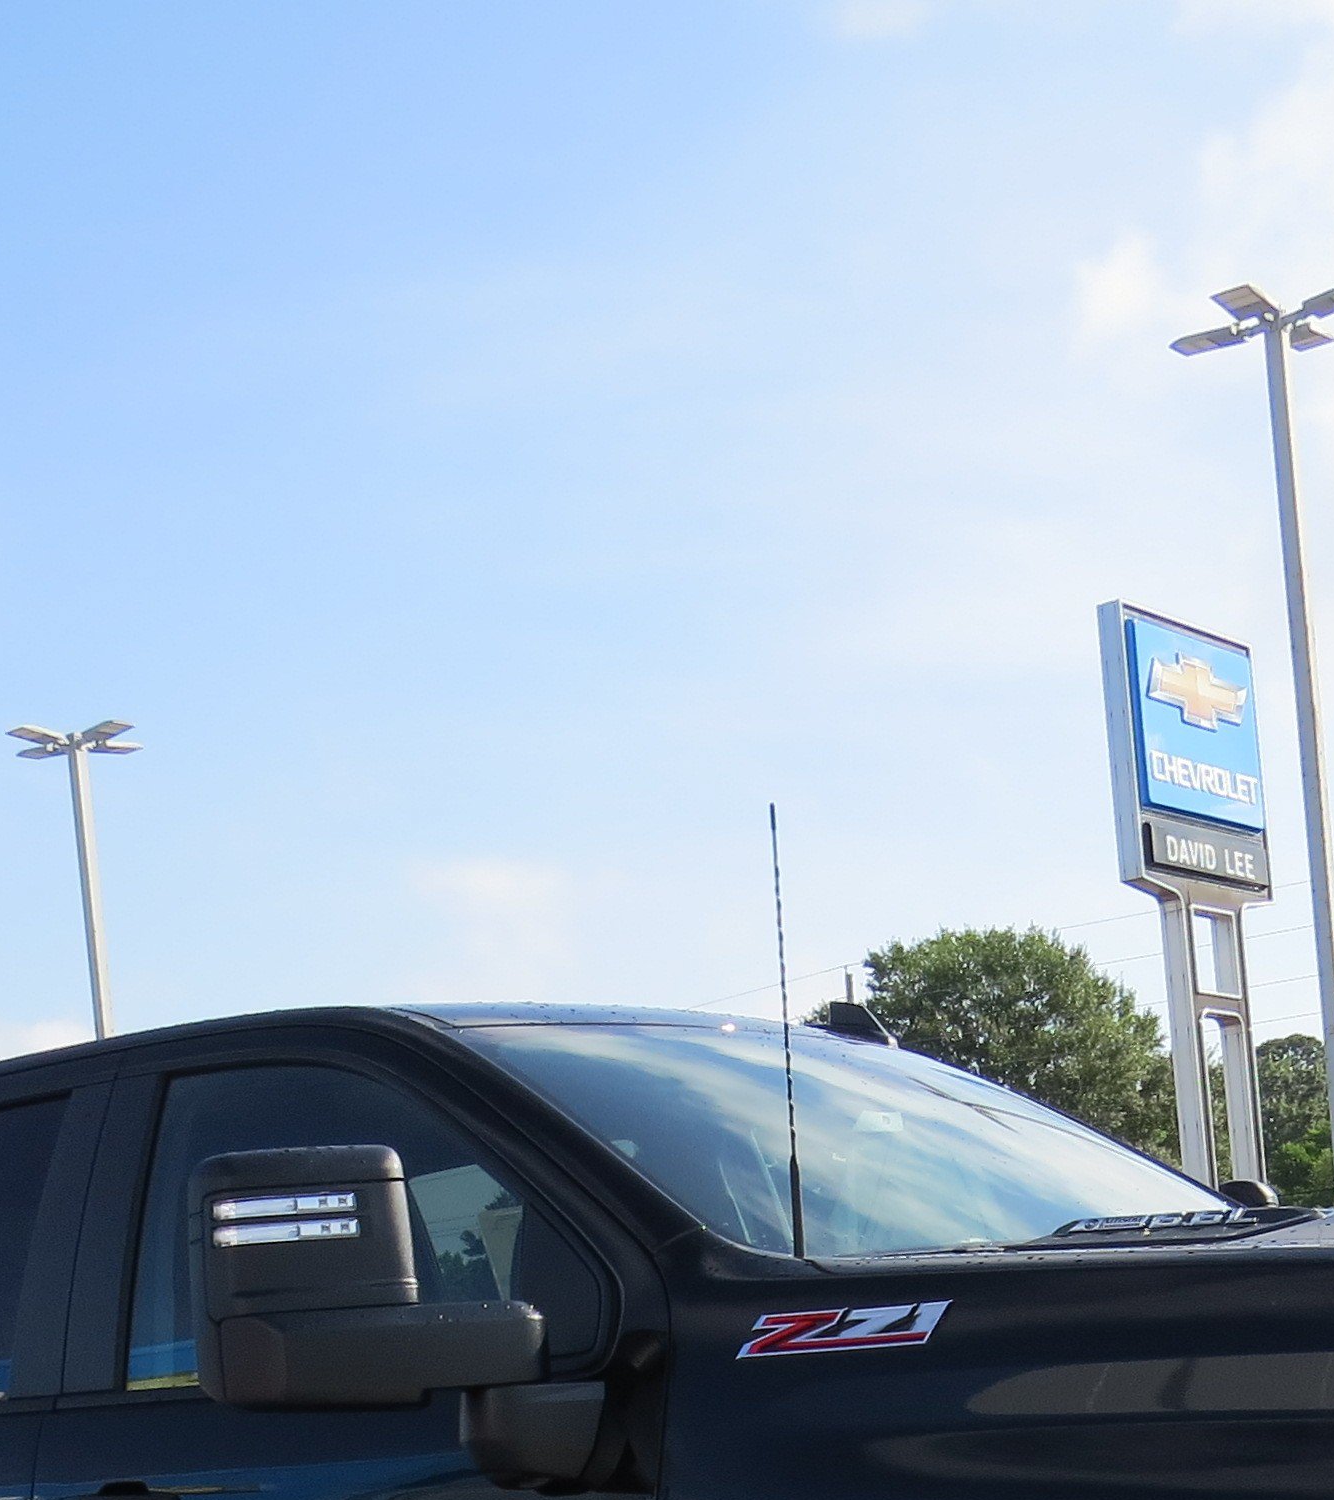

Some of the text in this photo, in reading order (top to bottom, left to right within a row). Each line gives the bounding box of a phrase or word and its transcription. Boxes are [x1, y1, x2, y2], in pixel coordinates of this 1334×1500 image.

[1150, 749, 1259, 805] CHEVROLET
[1166, 835, 1255, 880] DAVID LEE
[735, 1299, 954, 1360] Z71
